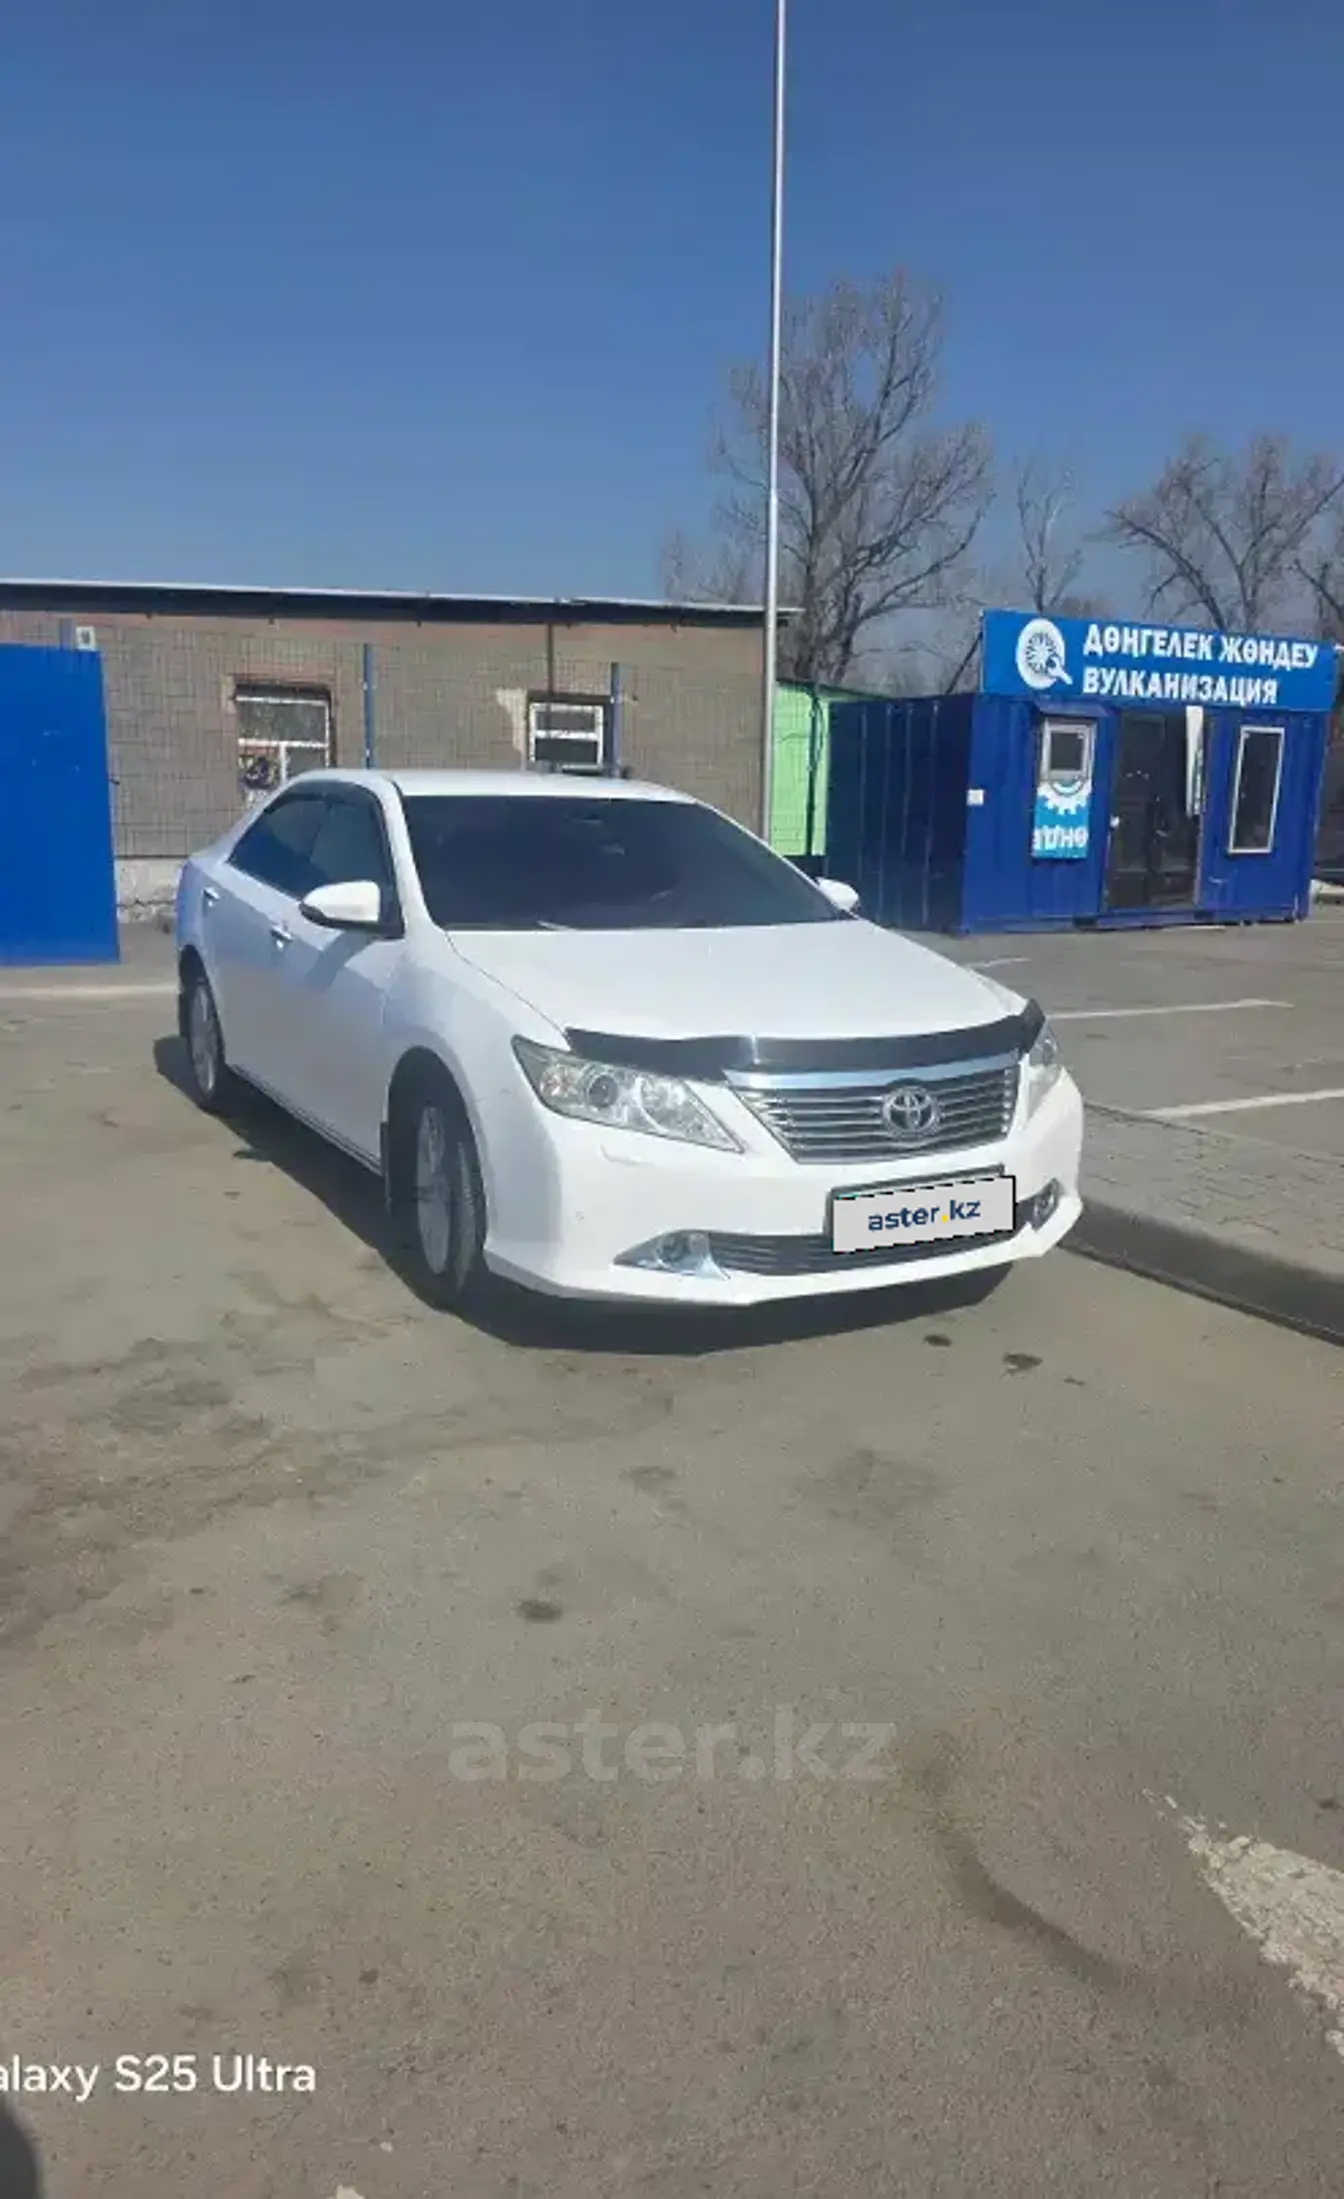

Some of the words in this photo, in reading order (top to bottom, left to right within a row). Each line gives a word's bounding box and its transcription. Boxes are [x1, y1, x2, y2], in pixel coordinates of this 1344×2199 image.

[1083, 623, 1215, 661] ДӨҢГЕЛЕК
[1219, 634, 1318, 672] ЖӨНДЕУ
[1082, 666, 1278, 705] ВУЛКАНИЗАЦИЯ
